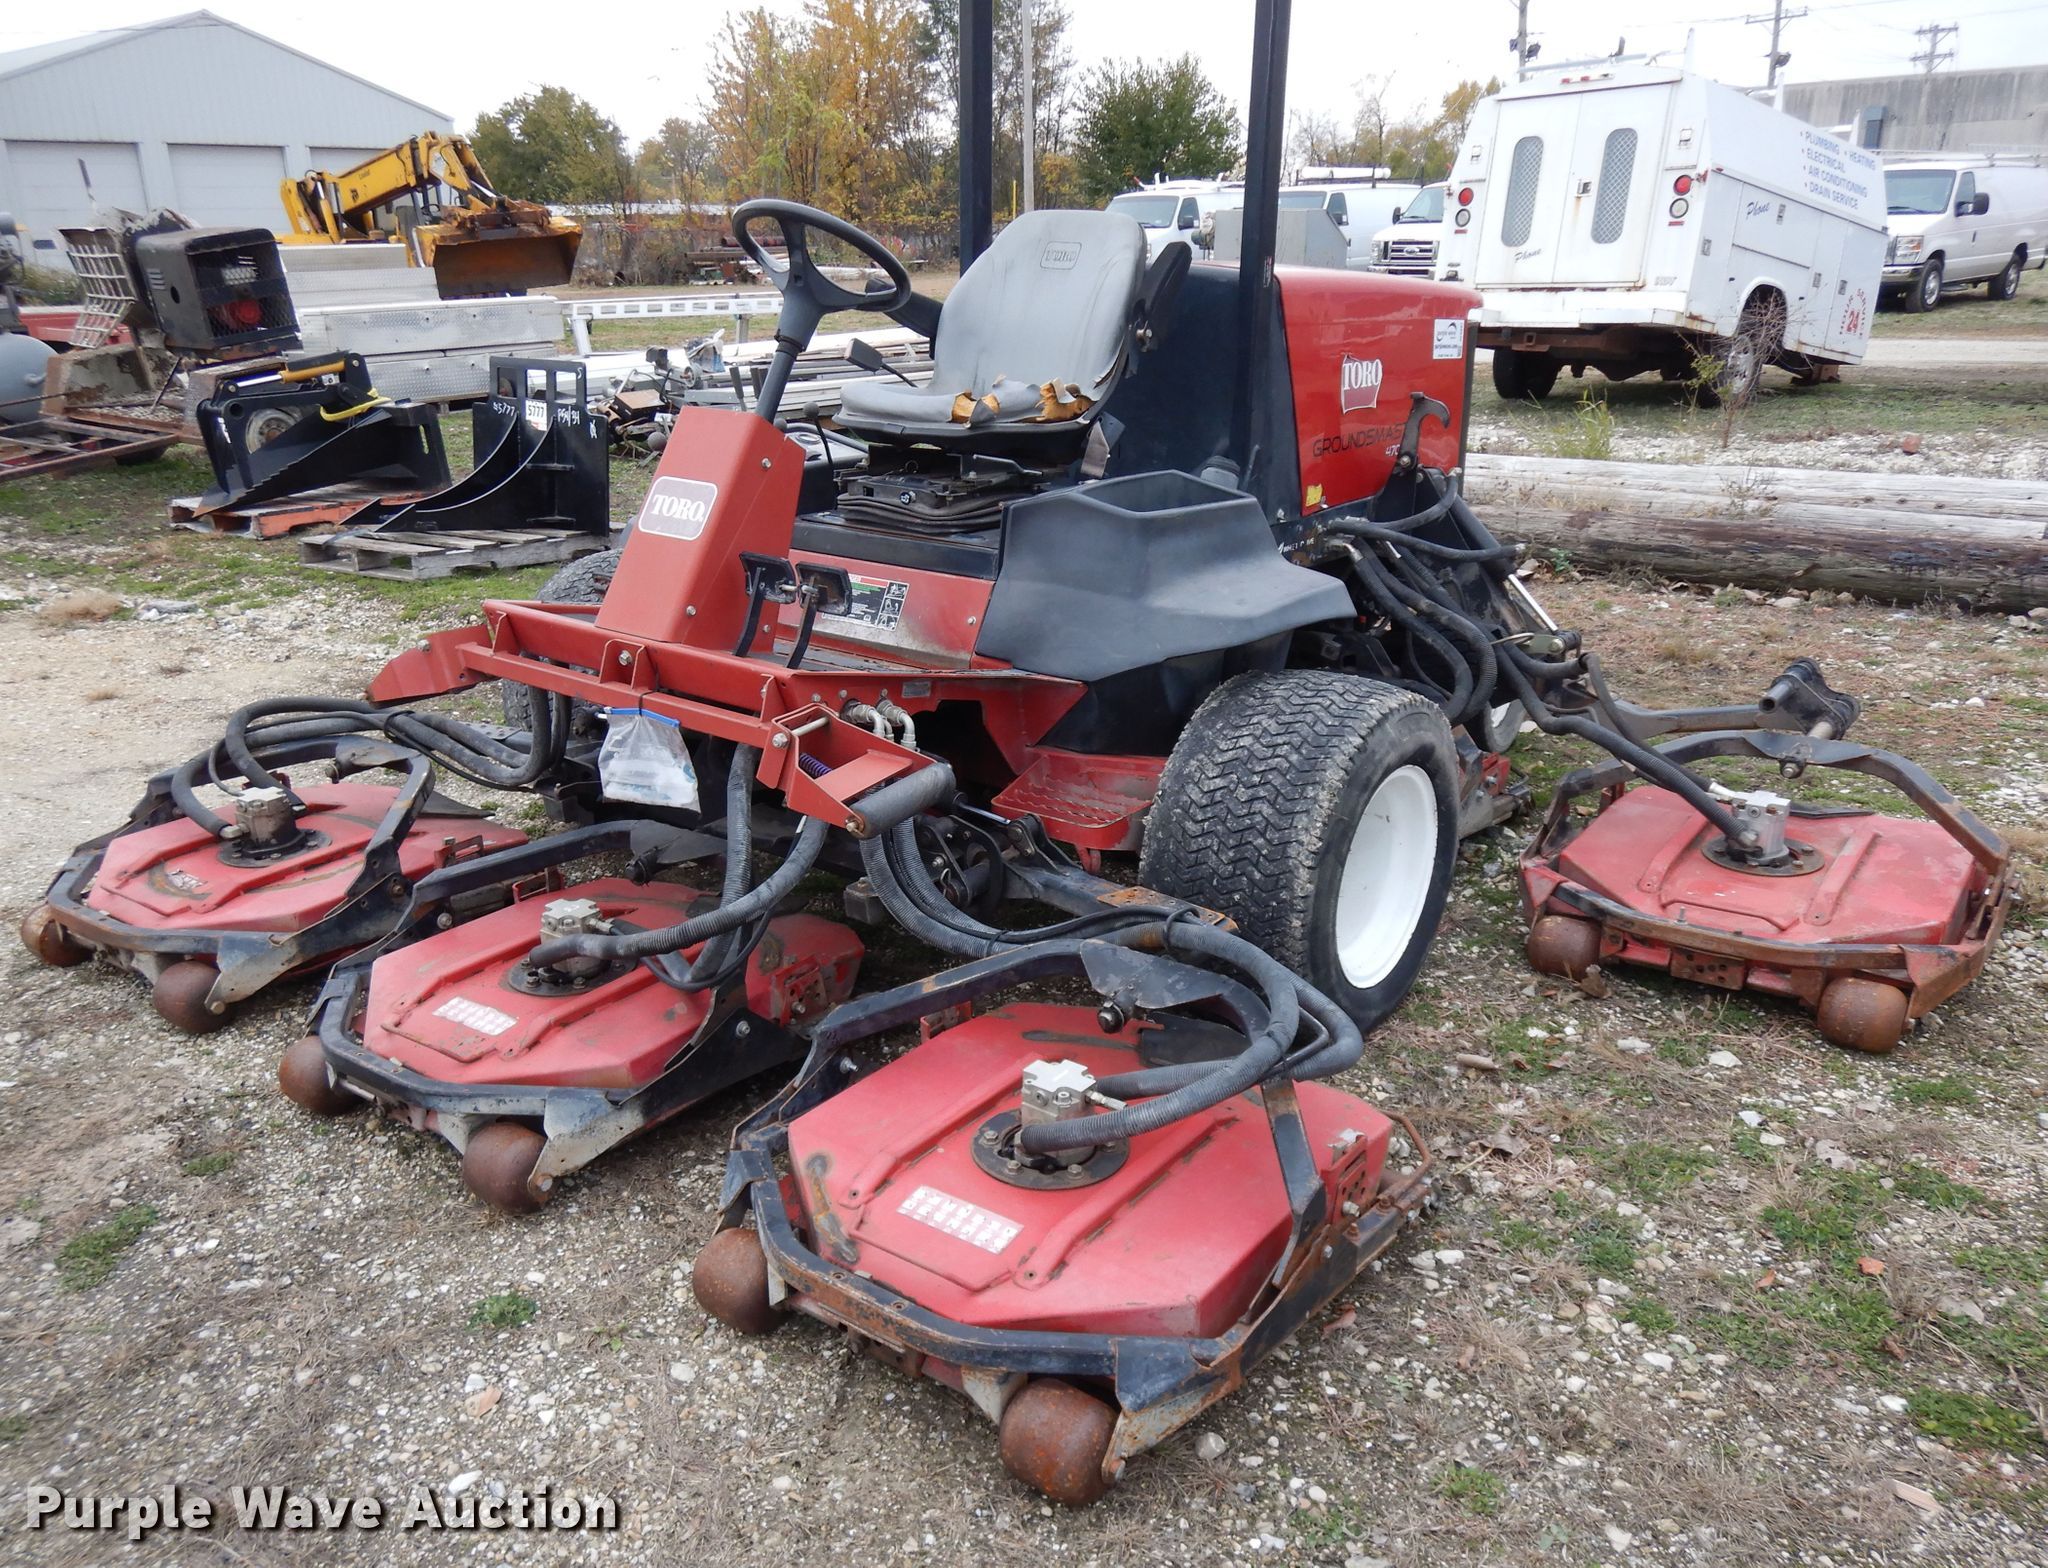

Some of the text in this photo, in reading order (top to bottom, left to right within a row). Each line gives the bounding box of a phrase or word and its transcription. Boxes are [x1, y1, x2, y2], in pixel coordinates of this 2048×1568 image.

[1805, 131, 1876, 171] PLUMBING HEATING
[1807, 148, 1846, 173] ELECTRICAL
[1808, 165, 1868, 198] AIR CONDITIONING
[1809, 181, 1858, 210] DRAIN SERVICE
[1343, 359, 1382, 390] TORO
[527, 404, 545, 418] 5777
[1313, 423, 1406, 457] GROUNDSMAS
[651, 494, 706, 522] TORO
